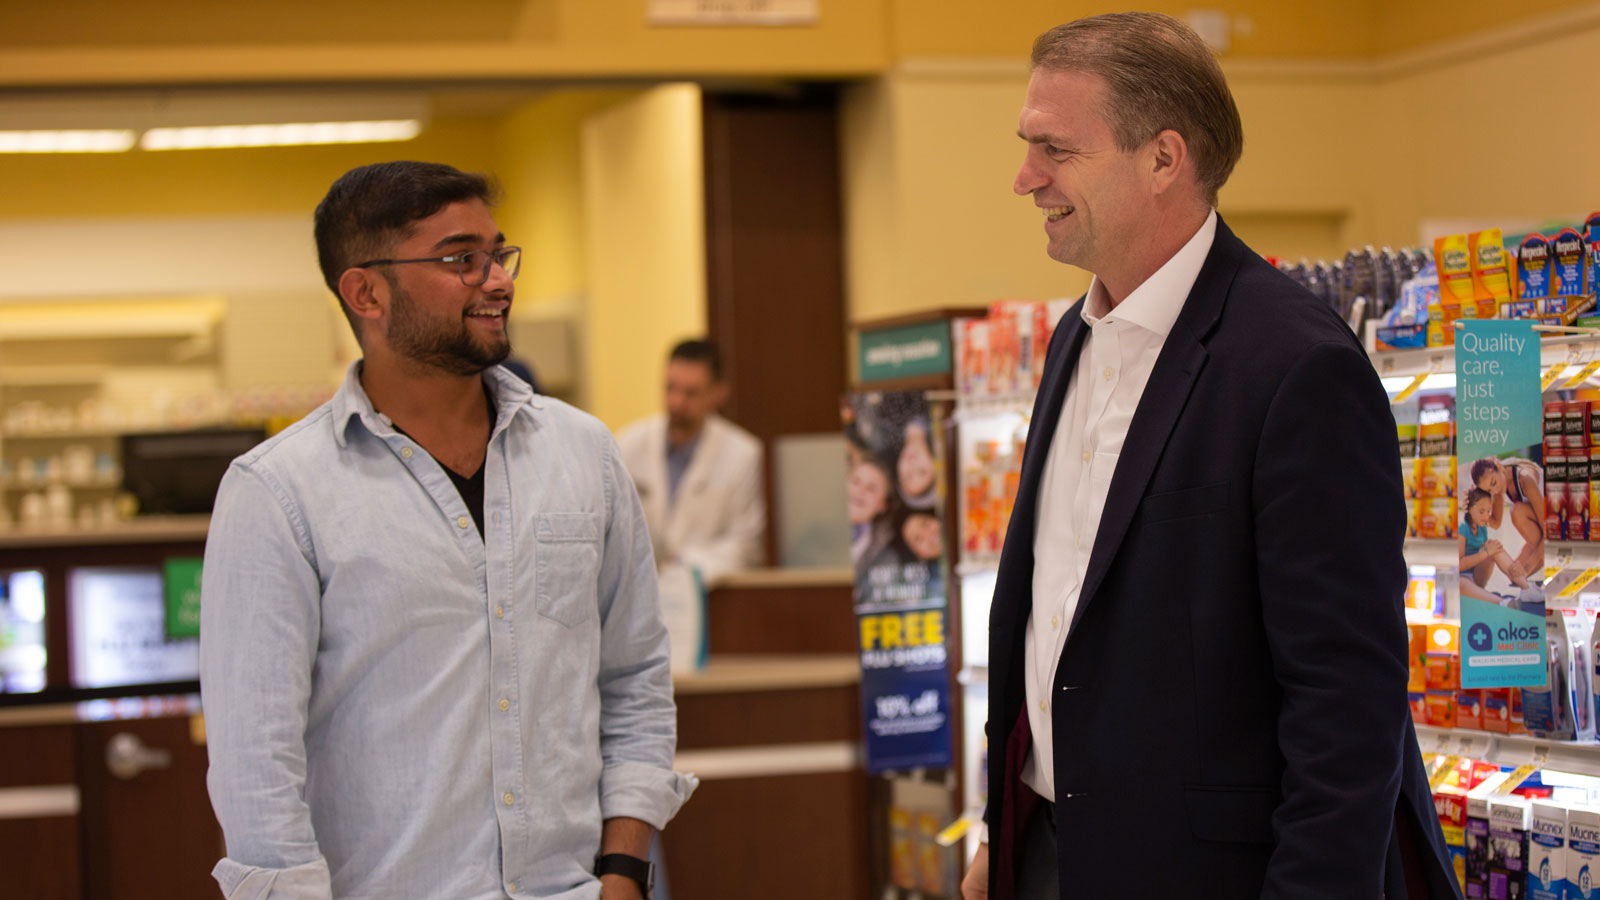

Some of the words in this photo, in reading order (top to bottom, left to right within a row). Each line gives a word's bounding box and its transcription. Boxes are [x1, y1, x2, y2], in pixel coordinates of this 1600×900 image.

[1462, 331, 1526, 356] Quality
[1462, 360, 1504, 376] care,
[1462, 378, 1494, 402] just
[1463, 403, 1510, 424] steps
[1464, 428, 1510, 447] away
[861, 609, 944, 651] FREE
[1497, 621, 1540, 641] akos
[893, 644, 947, 667] SHOTS
[1497, 642, 1516, 651] Med
[1517, 640, 1540, 651] Clinic
[911, 689, 939, 716] off
[1532, 817, 1564, 837] Mucinex
[1570, 825, 1600, 842] Mucine
